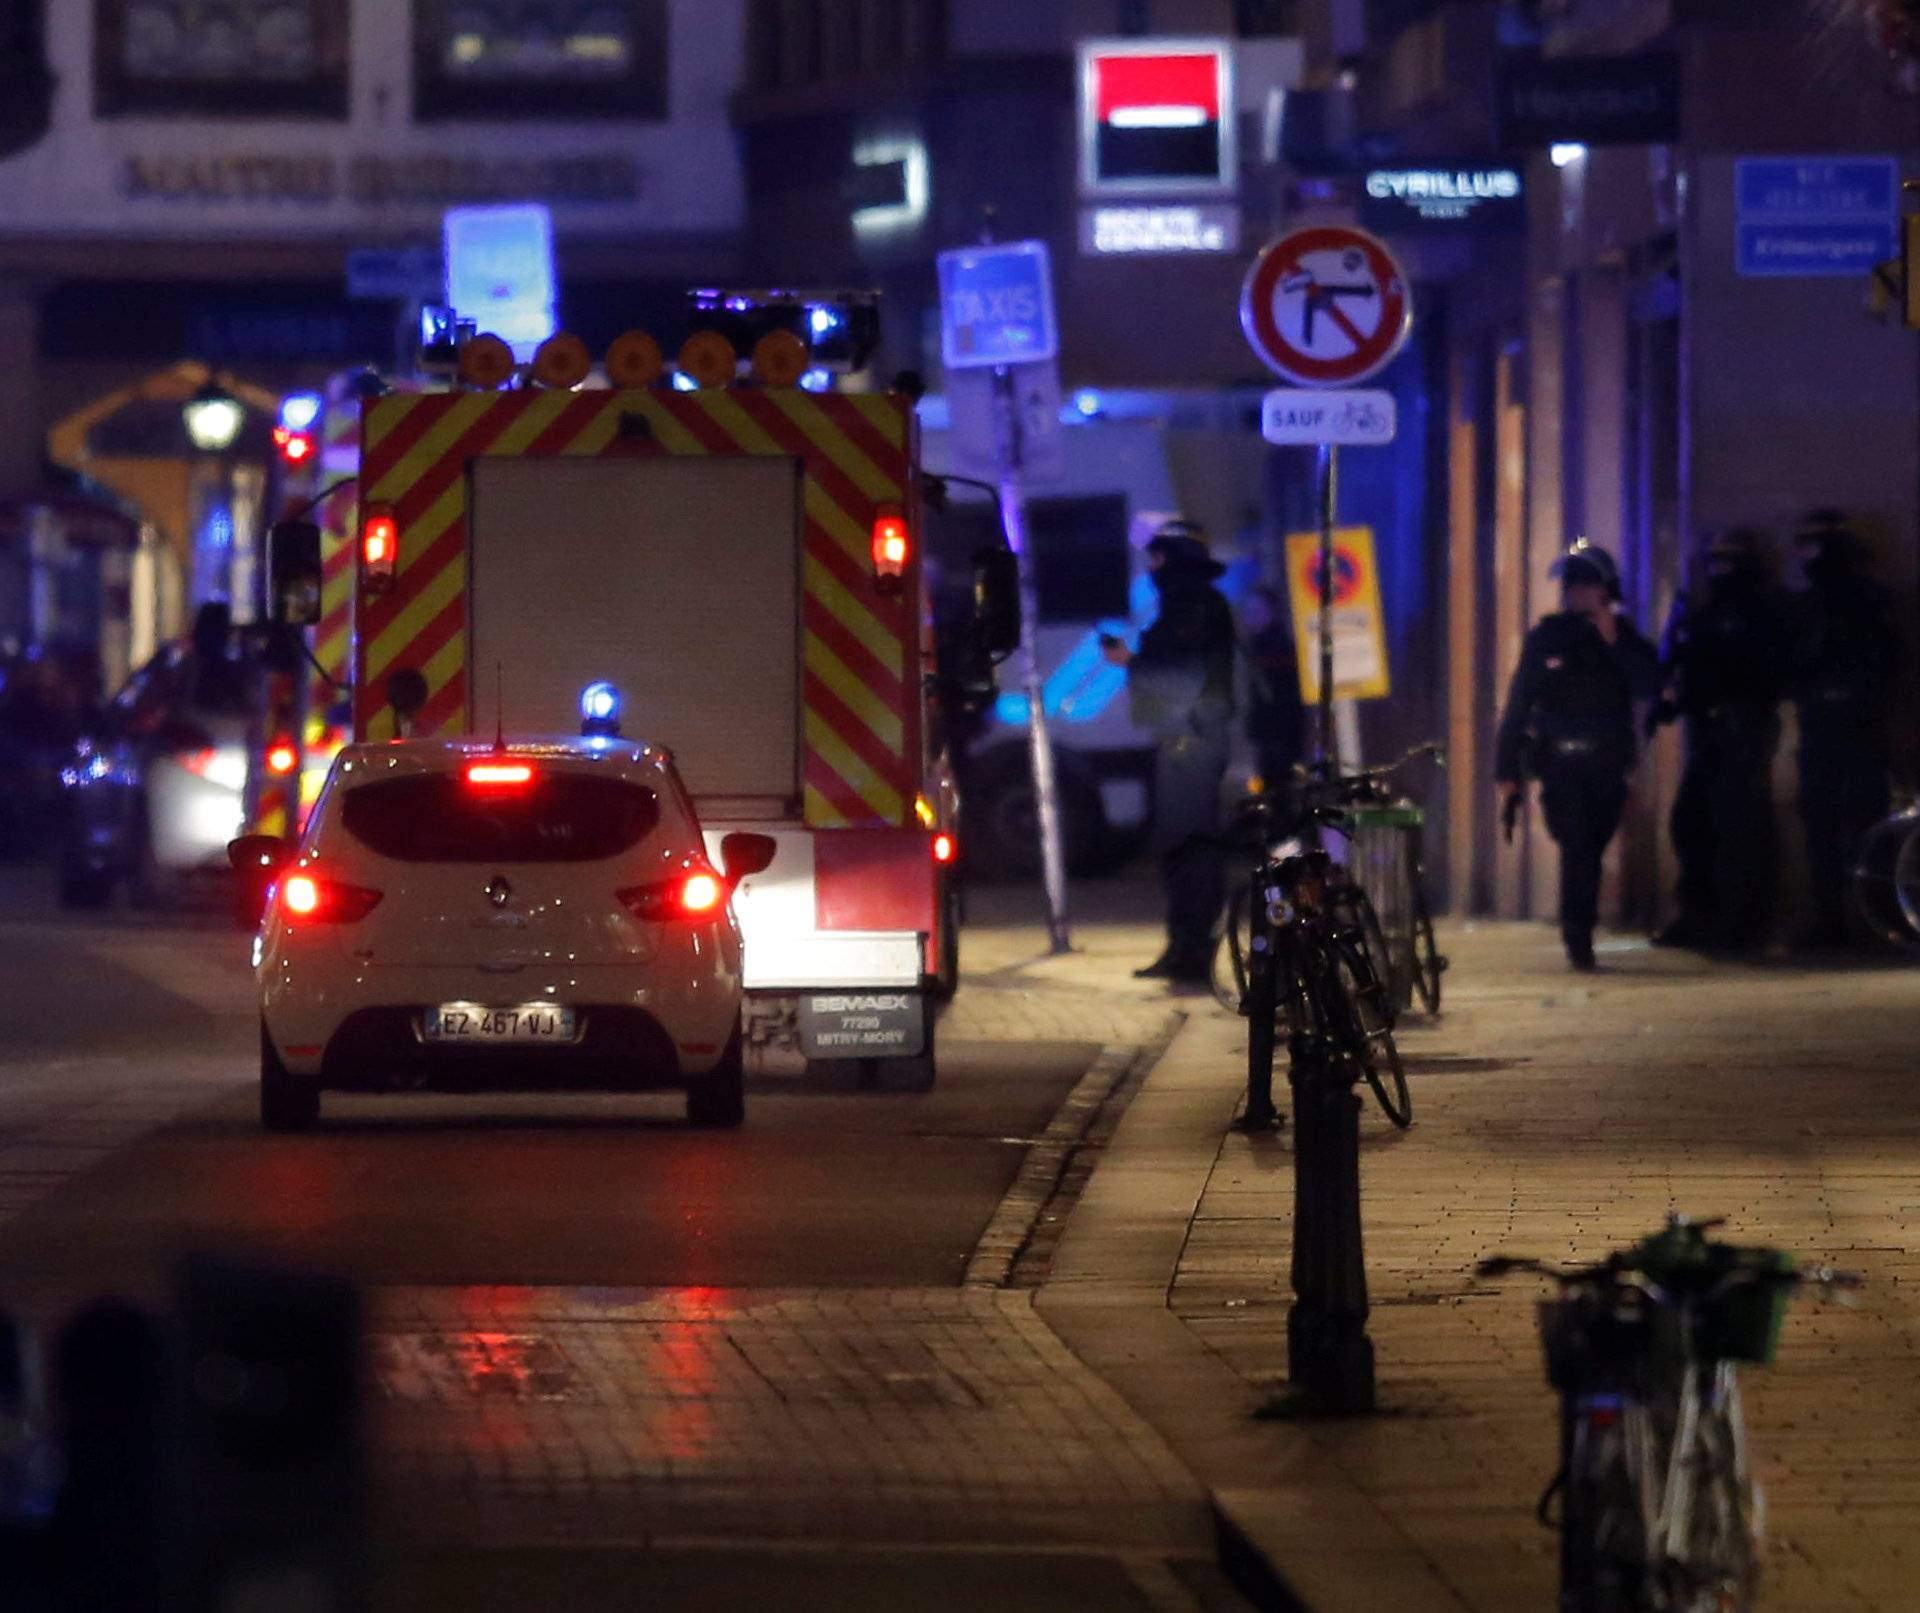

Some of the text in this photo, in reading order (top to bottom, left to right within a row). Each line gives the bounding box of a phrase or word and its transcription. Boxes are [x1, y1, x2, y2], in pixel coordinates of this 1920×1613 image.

[1366, 171, 1518, 198] CYRILLUS
[949, 285, 1037, 323] TAXIS
[1272, 409, 1323, 426] SAUF
